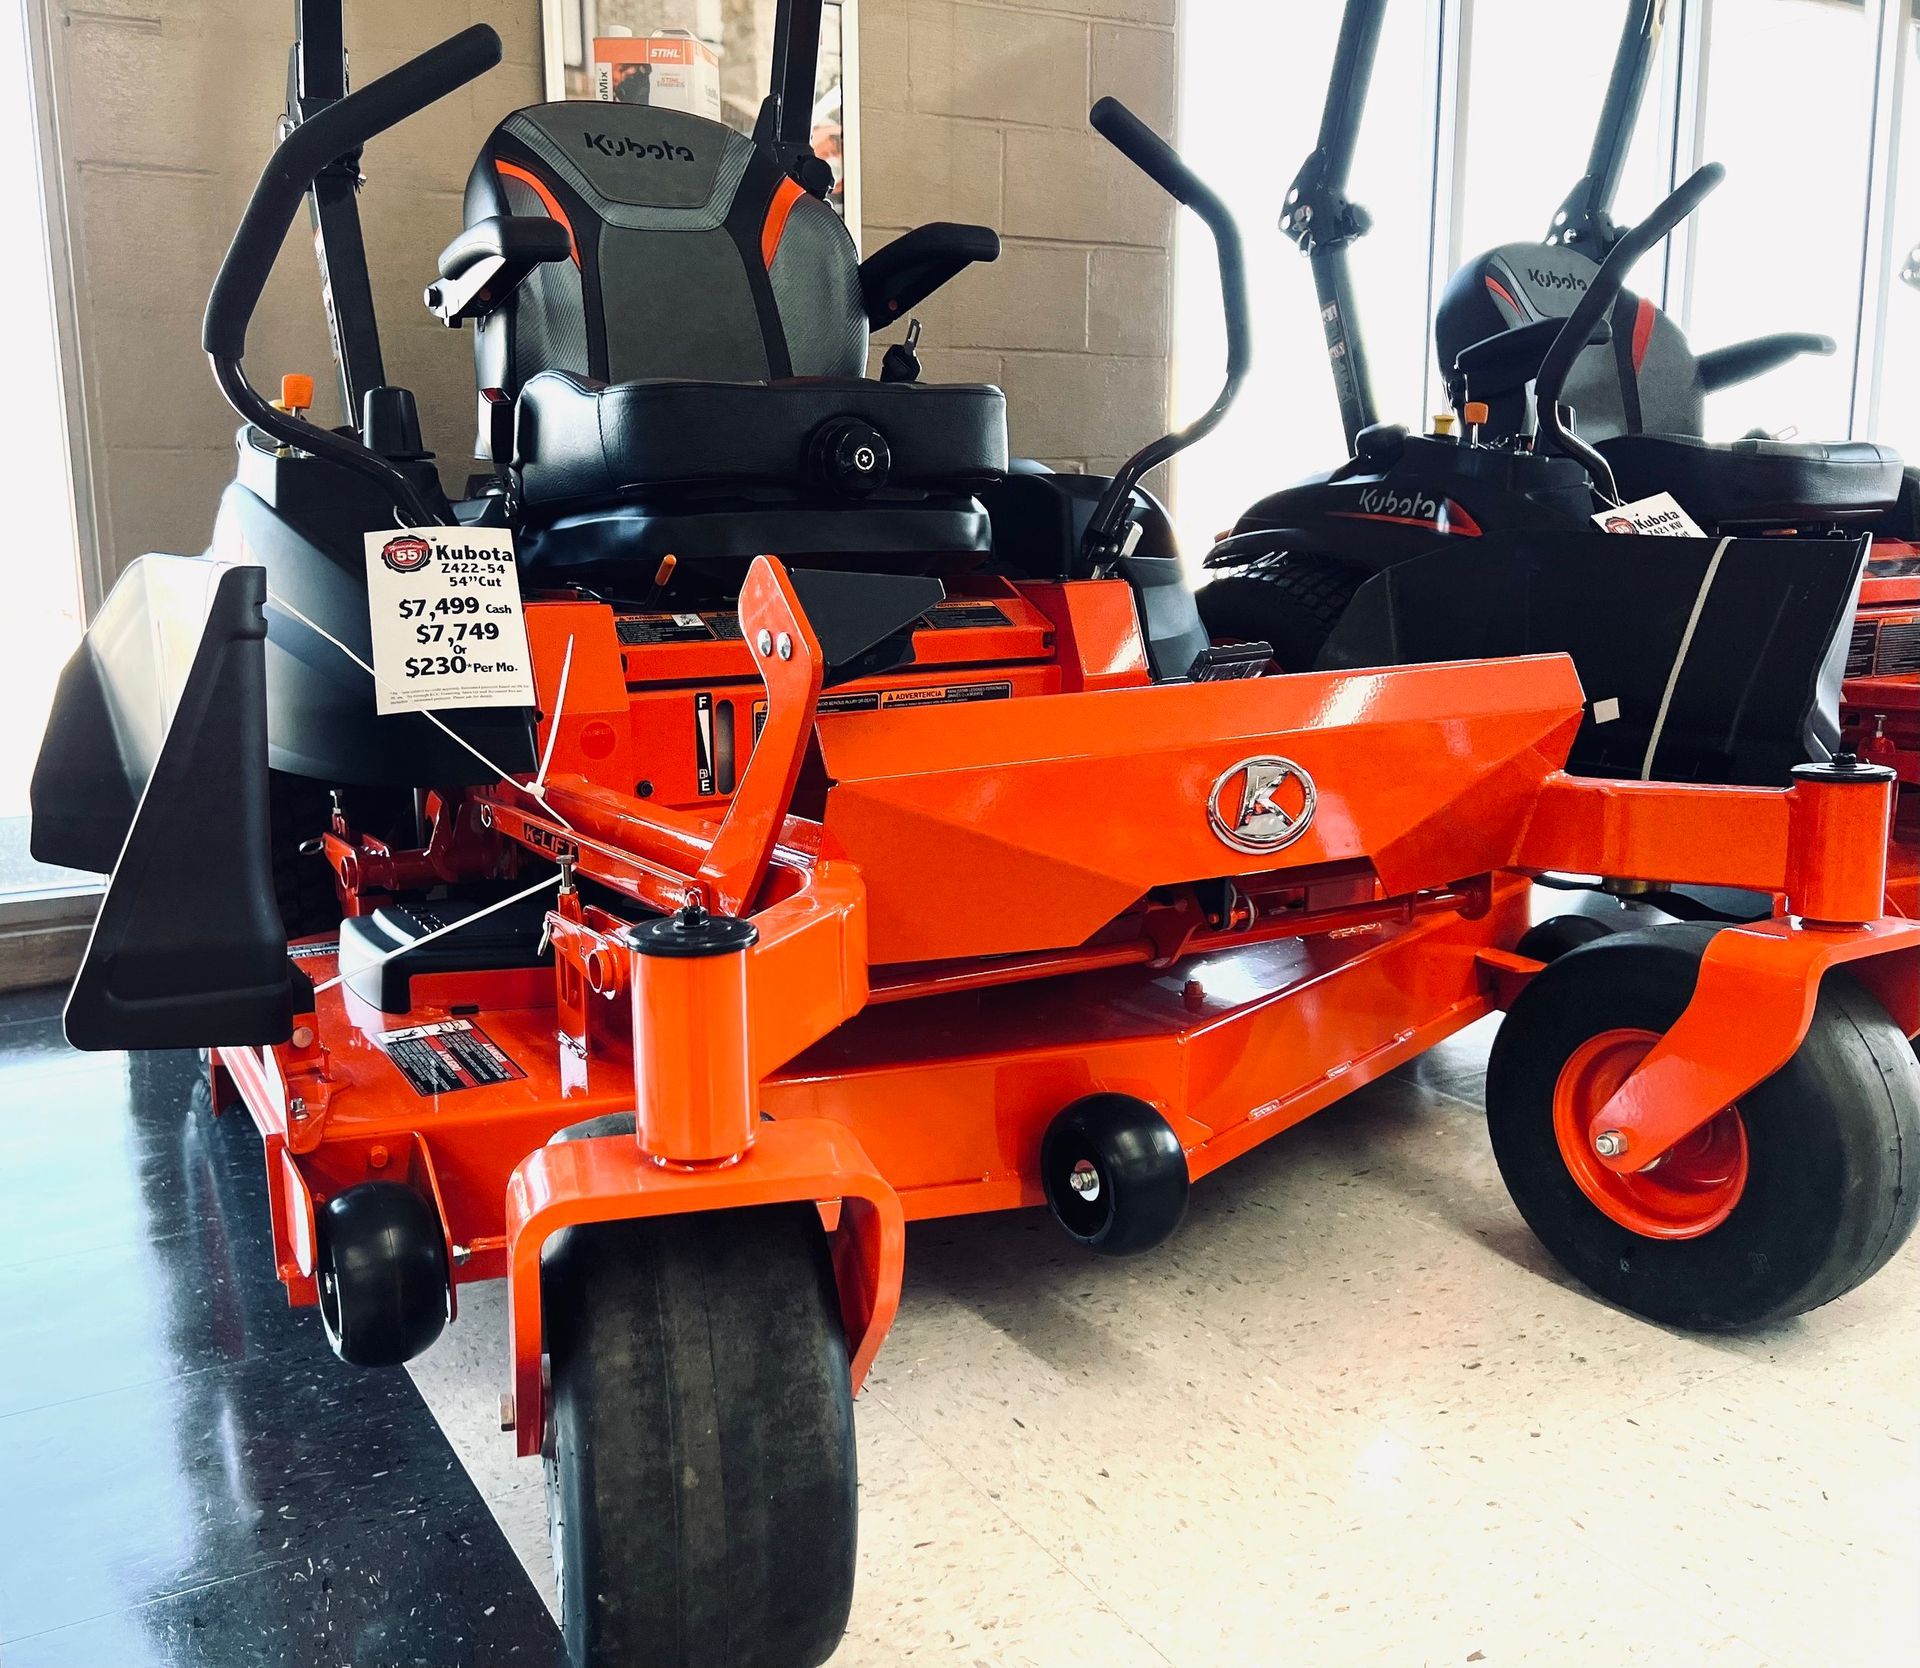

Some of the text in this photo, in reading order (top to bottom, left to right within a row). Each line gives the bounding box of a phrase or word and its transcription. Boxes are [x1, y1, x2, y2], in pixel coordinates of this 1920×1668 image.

[650, 48, 681, 58] STIHL
[584, 132, 695, 161] Kubota
[1528, 268, 1588, 291] Kubota
[1359, 488, 1436, 518] Kubota
[1634, 511, 1680, 529] Kubota
[396, 549, 419, 561] 55
[436, 545, 513, 562] Kubota
[441, 563, 506, 574] Z422-54
[399, 597, 512, 621] $7,499 Cash
[416, 623, 499, 647] $7,749
[453, 645, 467, 655] Or
[496, 662, 518, 672] Mo.
[698, 696, 707, 709] F
[895, 690, 942, 701] ADVERTENCIA
[701, 780, 710, 791] E
[525, 825, 577, 857] K-LIFT
